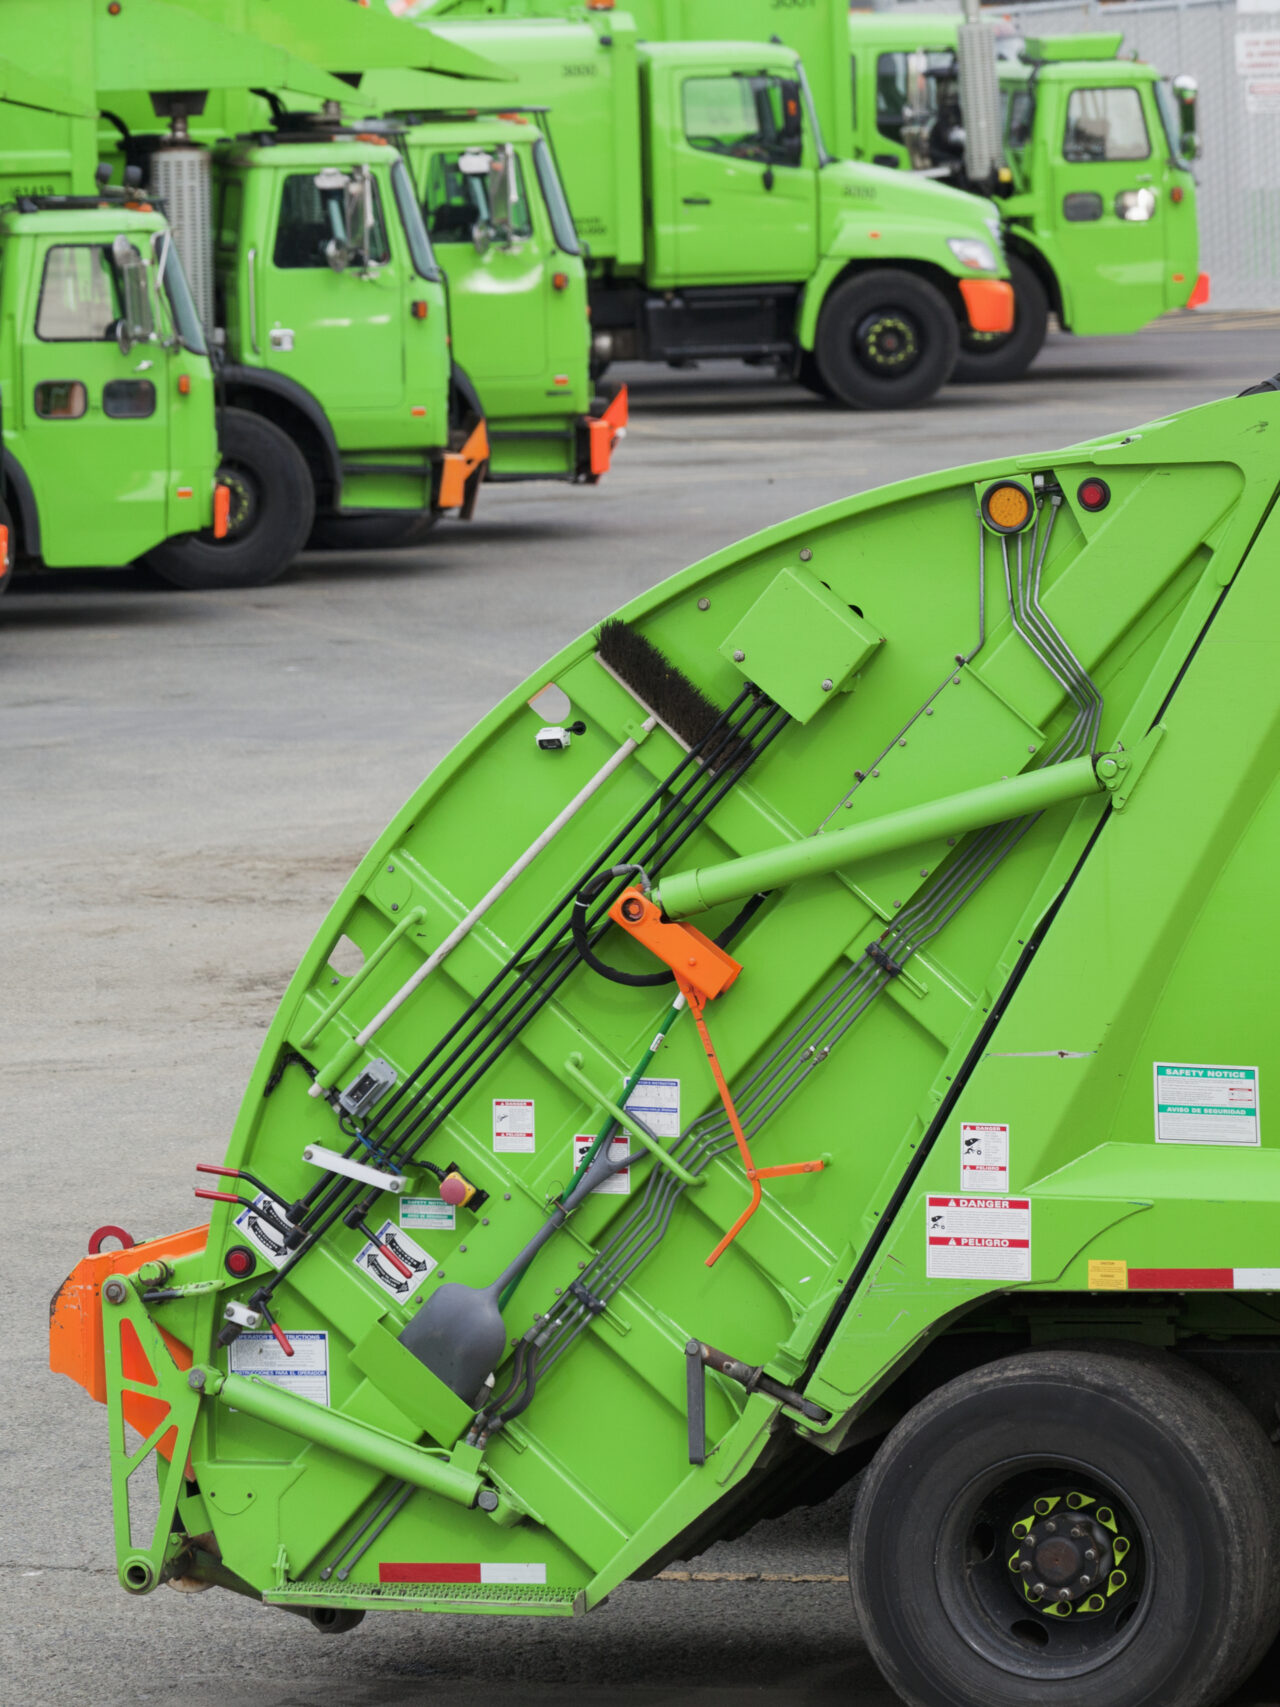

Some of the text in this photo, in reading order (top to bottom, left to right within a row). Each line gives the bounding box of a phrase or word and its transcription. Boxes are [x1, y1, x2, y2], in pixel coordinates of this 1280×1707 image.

[1165, 1068, 1246, 1079] SAFETY NOTICE
[1203, 1107, 1247, 1115] SEGURIDAD
[959, 1199, 1010, 1208] DANGER
[960, 1238, 1010, 1247] PELIGRO
